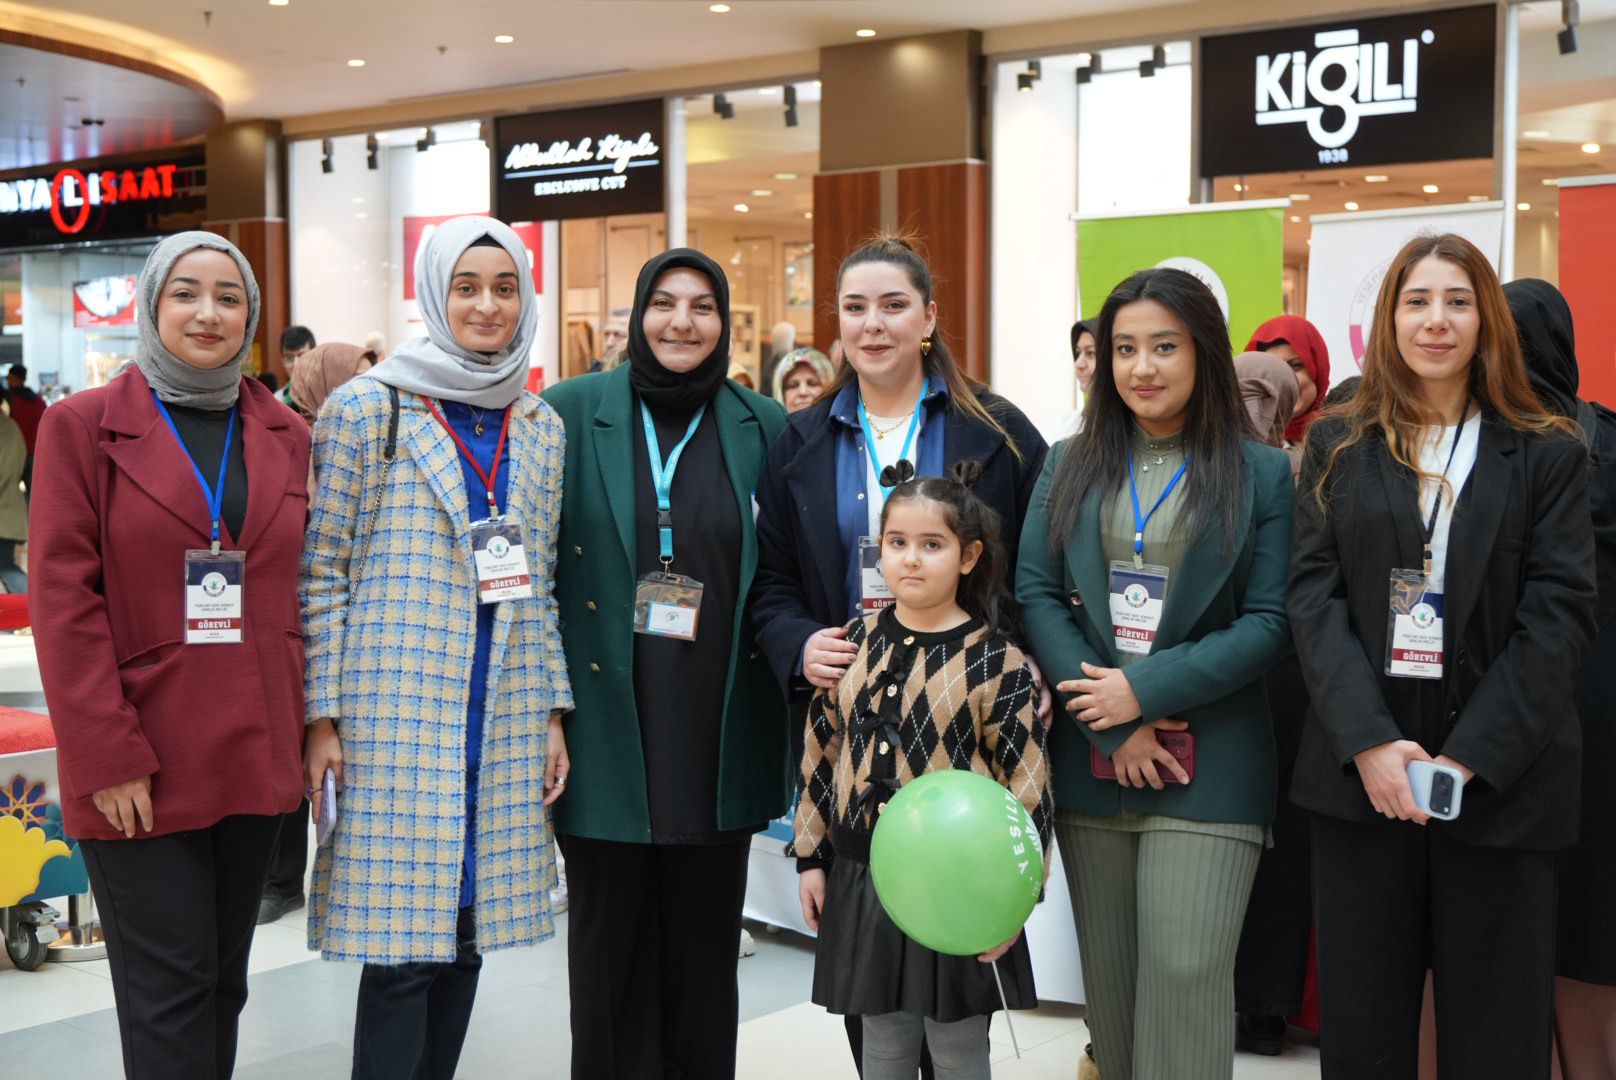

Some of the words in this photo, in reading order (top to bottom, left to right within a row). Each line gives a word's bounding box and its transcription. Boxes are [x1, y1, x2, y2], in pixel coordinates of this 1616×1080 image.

[1317, 148, 1349, 163] 1938
[533, 177, 600, 197] EXCLUSIVE
[600, 175, 628, 191] CUT
[489, 576, 521, 589] GÖREVLİ
[198, 618, 231, 629] GÖREVLİ
[1116, 628, 1149, 640] GÖREVLİ
[1403, 651, 1438, 662] GÖREVLİ
